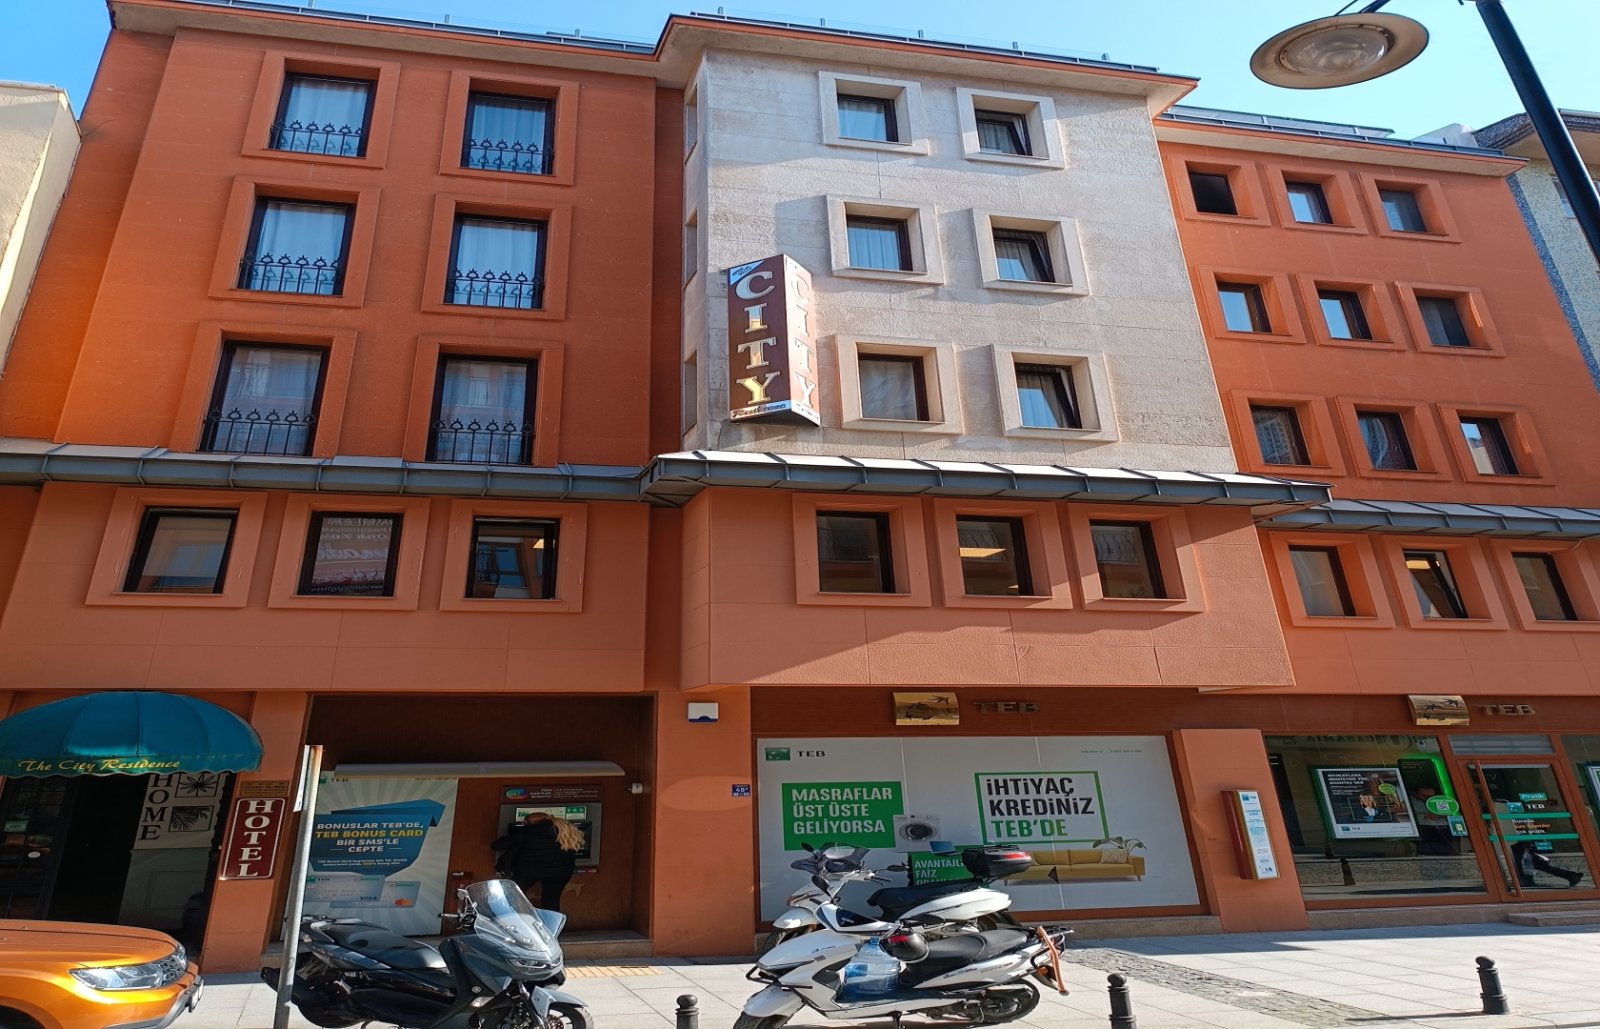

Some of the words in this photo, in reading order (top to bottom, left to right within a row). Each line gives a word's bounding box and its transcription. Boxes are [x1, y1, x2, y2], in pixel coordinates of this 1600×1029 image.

[736, 271, 781, 405] CITY
[973, 701, 1040, 714] TEB
[1476, 704, 1536, 716] TEB
[797, 750, 826, 758] TEB
[18, 760, 52, 772] The
[59, 760, 96, 773] City
[100, 759, 181, 771] Residence
[792, 787, 893, 801] MASRAFLAR
[793, 802, 824, 818] ÜST
[829, 801, 869, 817] ÜSTE
[343, 830, 386, 838] BONUS
[389, 829, 424, 837] CARD
[793, 818, 886, 835] GELİYORSA
[990, 819, 1068, 838] TEB'DE
[237, 800, 276, 877] HOTEL
[358, 838, 399, 846] SMS'LE
[916, 869, 937, 878] FAİZ
